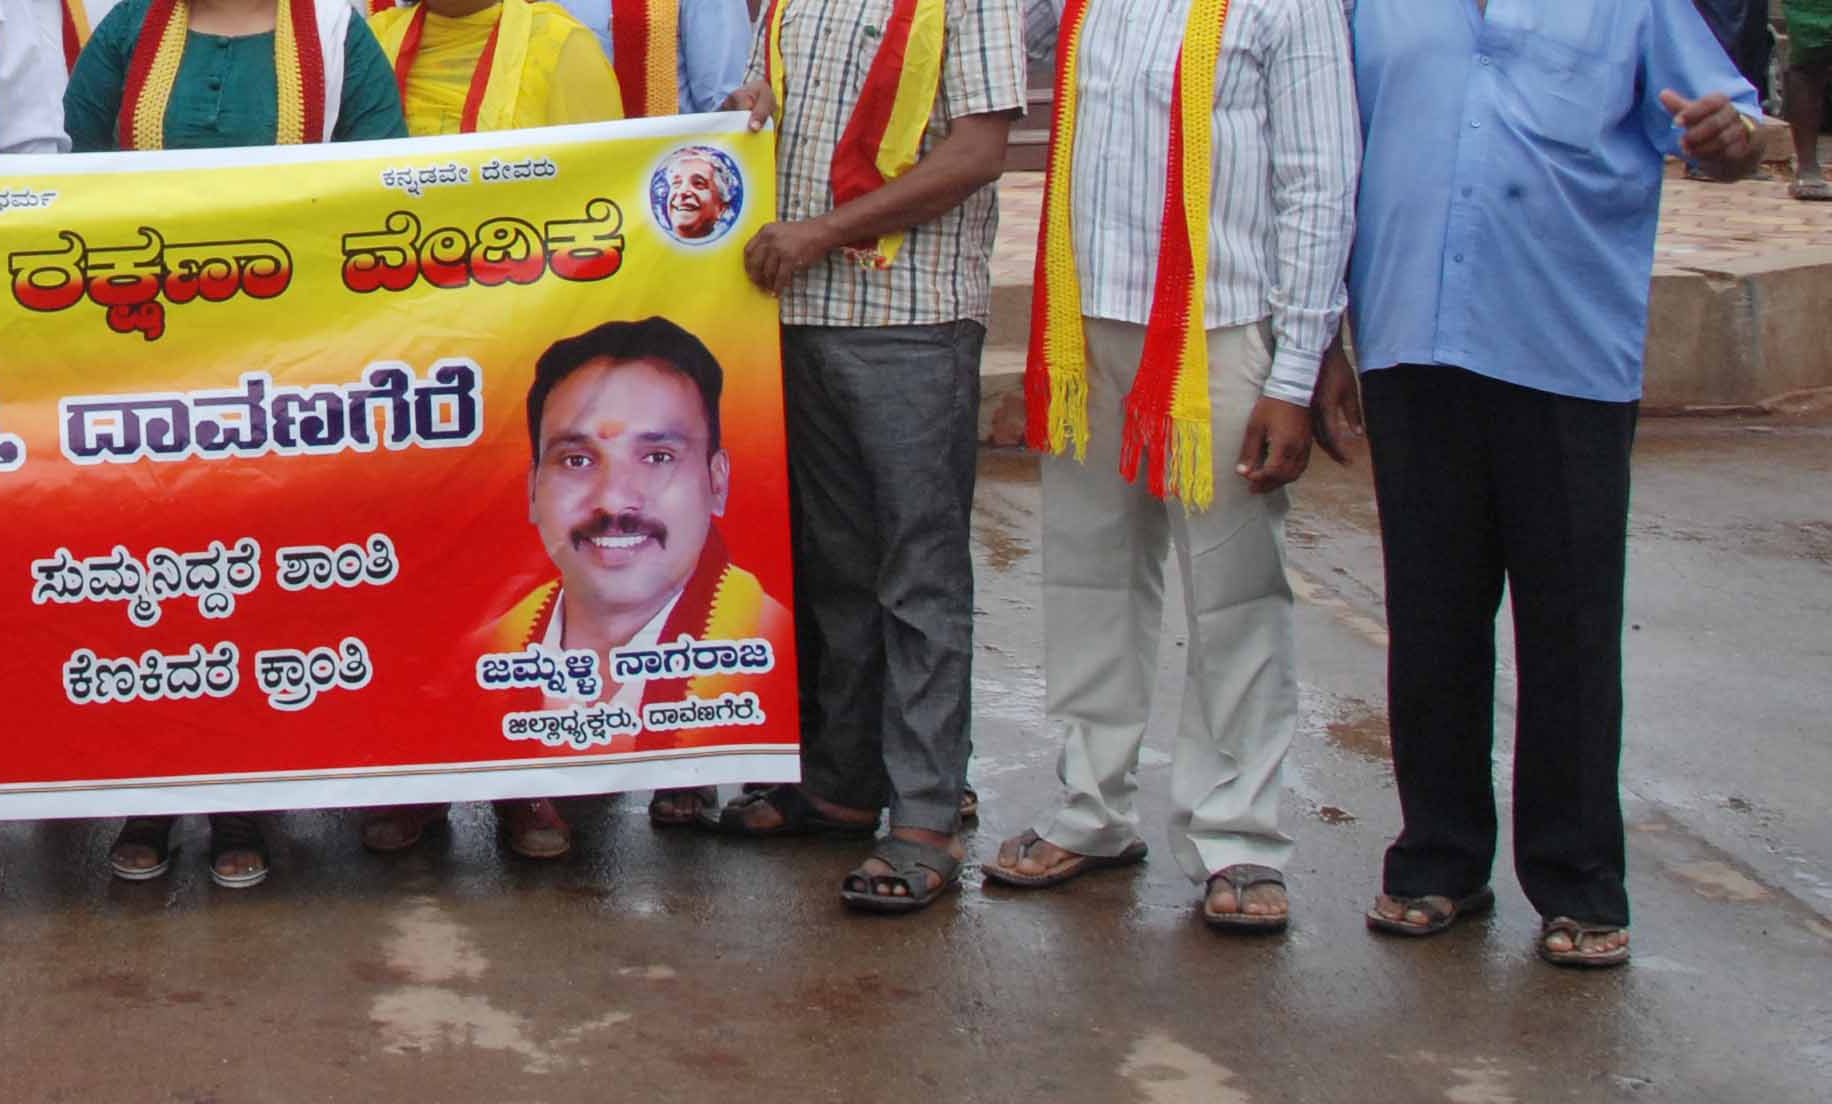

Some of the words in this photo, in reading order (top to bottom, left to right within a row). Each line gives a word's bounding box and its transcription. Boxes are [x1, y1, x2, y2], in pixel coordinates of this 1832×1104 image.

[382, 163, 469, 195] ಕನ್ನಡವೇ
[481, 158, 557, 181] ದೇವರು
[7, 226, 294, 341] ರಕ್ಷಣಾ
[340, 197, 626, 294] ವೇದಿಕೆ
[66, 365, 479, 458] ದಾವಣಗೆರೆ
[36, 542, 256, 622] ಸುಮ್ಮನಿದ್ದರೆ
[281, 537, 394, 586] ಶಾಂತಿ
[68, 646, 235, 700] ಕೆಣಕಿದರೆ
[260, 641, 369, 706] ಕ್ರಾಂತಿ
[614, 638, 770, 676] ನಾಗರಾಜ
[507, 707, 639, 744] ಜಿಲ್ಲಾಧ್ಯಕ್ಷರು,
